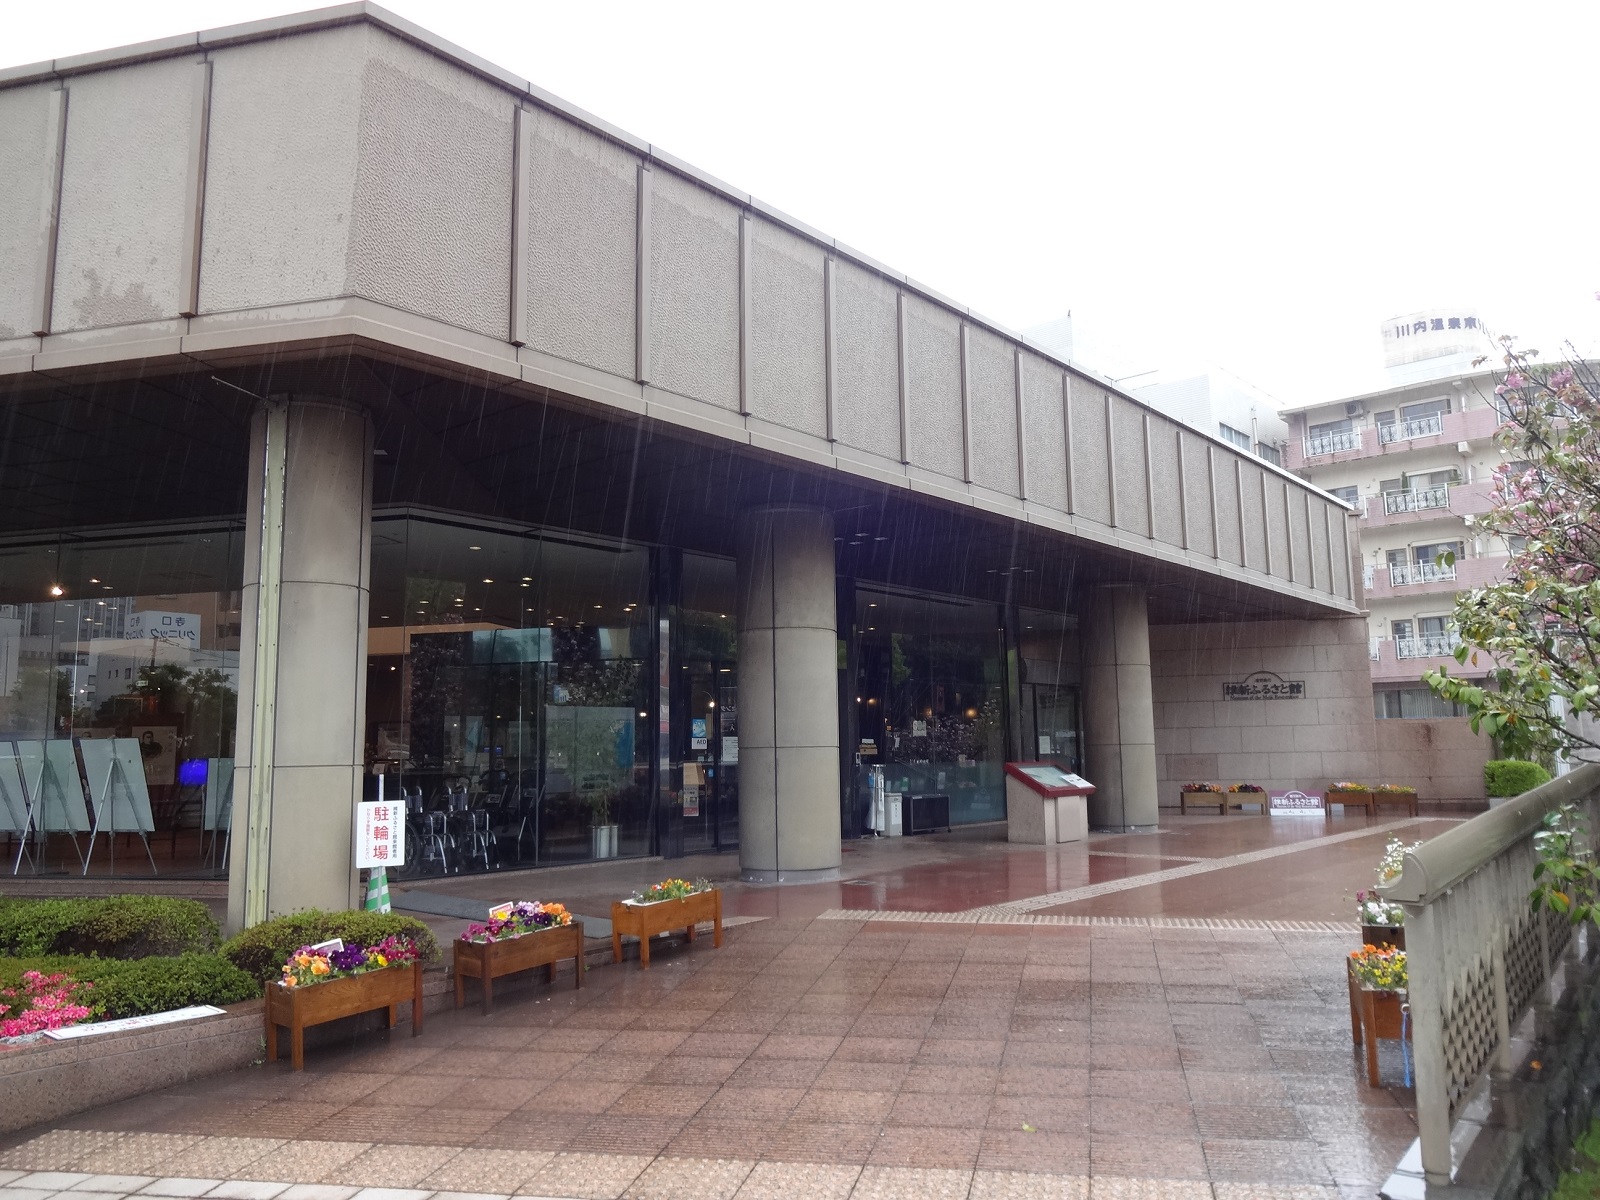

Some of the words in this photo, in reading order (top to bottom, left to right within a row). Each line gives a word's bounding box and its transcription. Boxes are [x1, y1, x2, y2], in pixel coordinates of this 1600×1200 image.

[1226, 683, 1302, 695] 維新ふるさと館
[373, 806, 389, 860] 駐輪場
